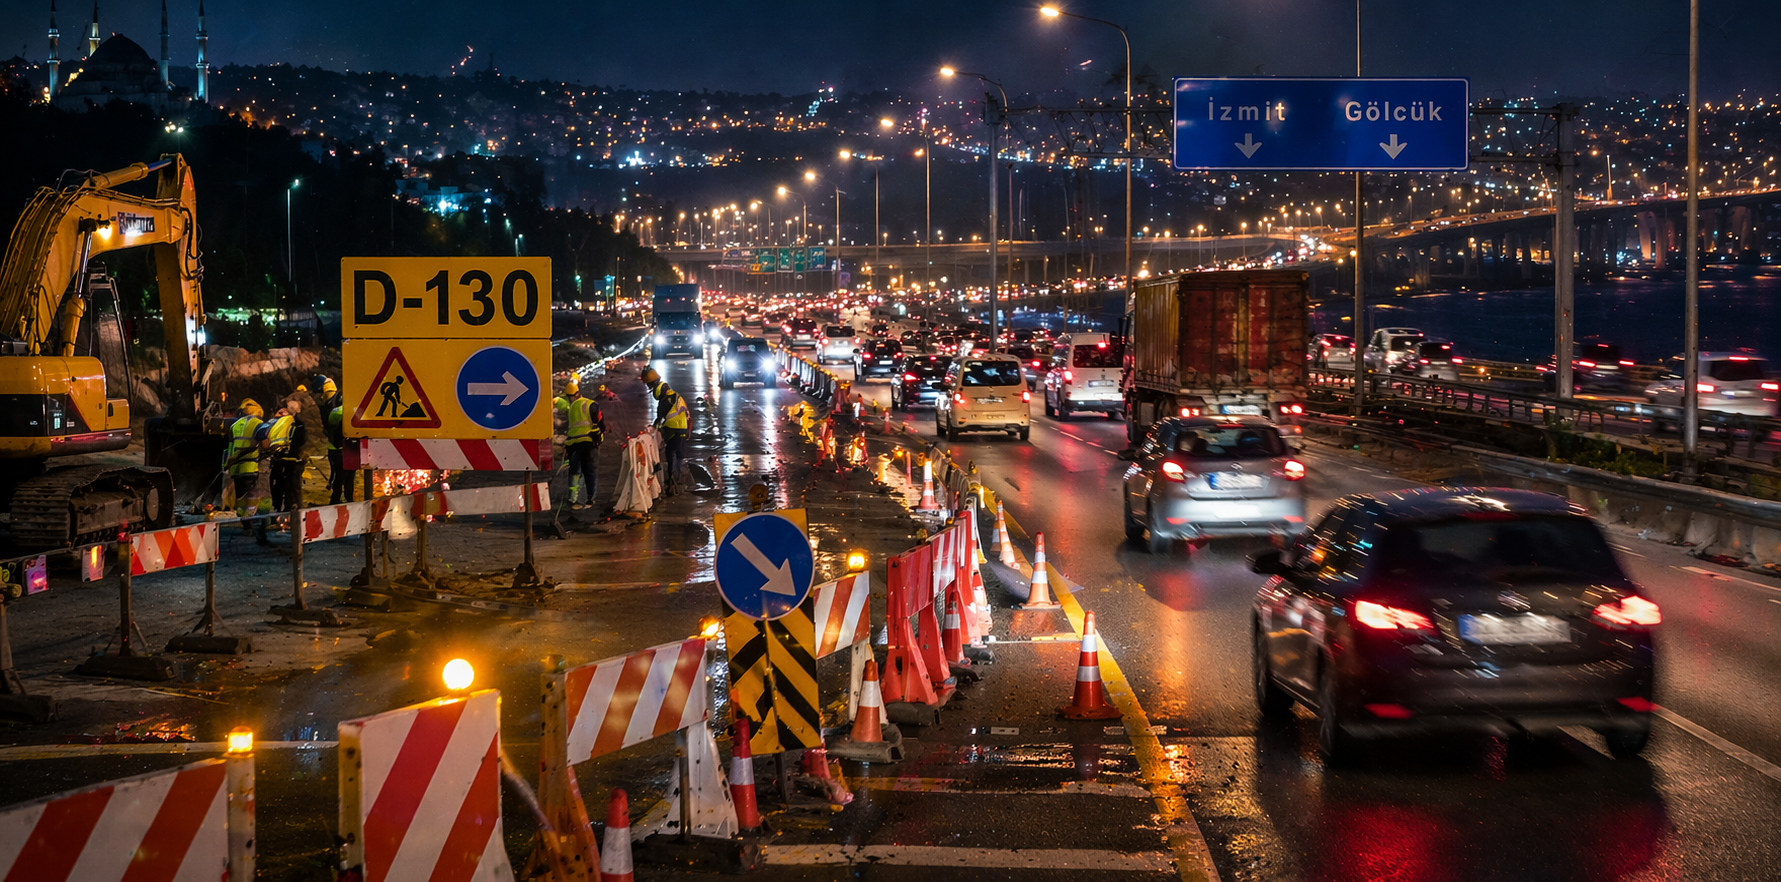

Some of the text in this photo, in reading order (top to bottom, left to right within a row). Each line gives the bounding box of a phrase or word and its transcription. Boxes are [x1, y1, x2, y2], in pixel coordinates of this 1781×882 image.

[1208, 97, 1287, 121] İzmit
[1345, 101, 1442, 122] Gölcük
[353, 269, 539, 326] D-130
